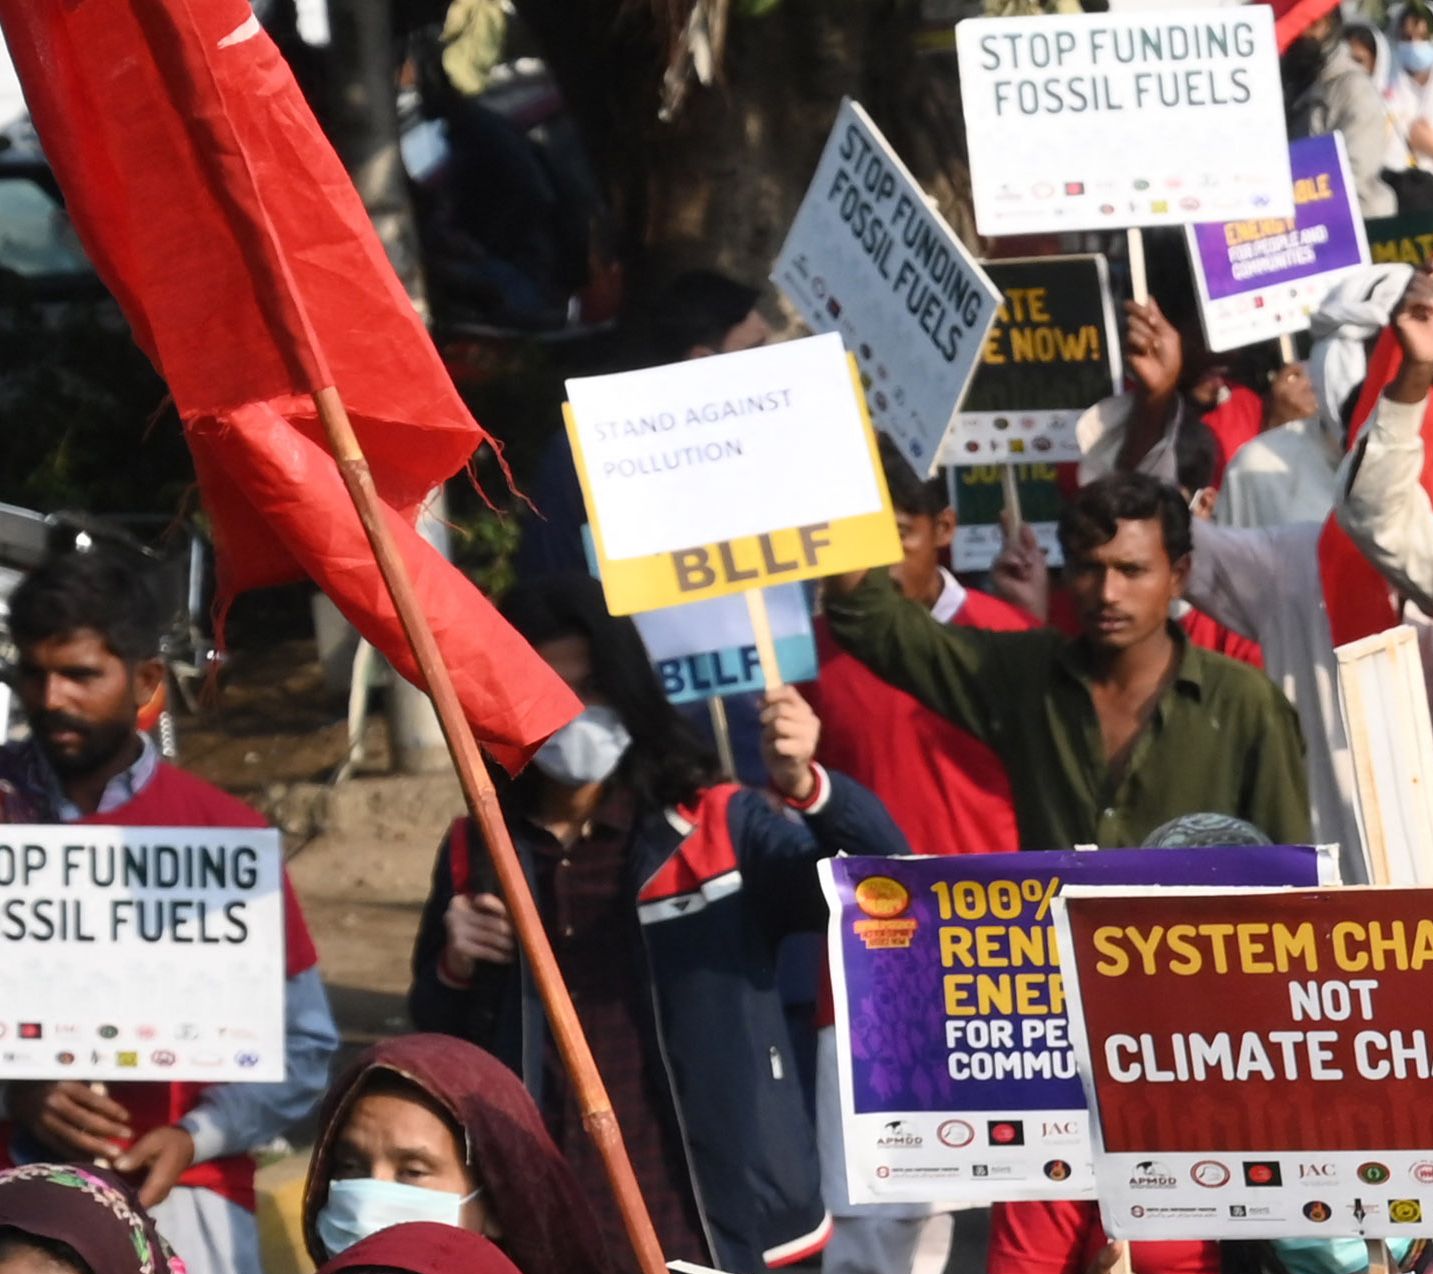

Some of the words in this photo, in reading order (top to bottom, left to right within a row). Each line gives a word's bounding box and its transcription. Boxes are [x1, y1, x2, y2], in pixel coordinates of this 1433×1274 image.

[979, 30, 1076, 72] STOP
[1089, 22, 1256, 66] FUNDING
[994, 76, 1123, 118] FOSSIL
[1134, 68, 1252, 108] FUELS
[63, 845, 259, 888] FUNDING
[110, 901, 250, 945] FUELS
[1094, 920, 1318, 978] SYSTEM
[1289, 979, 1379, 1022] NOT
[944, 1019, 1015, 1051] FOR
[1103, 1028, 1343, 1085] CLIMATE
